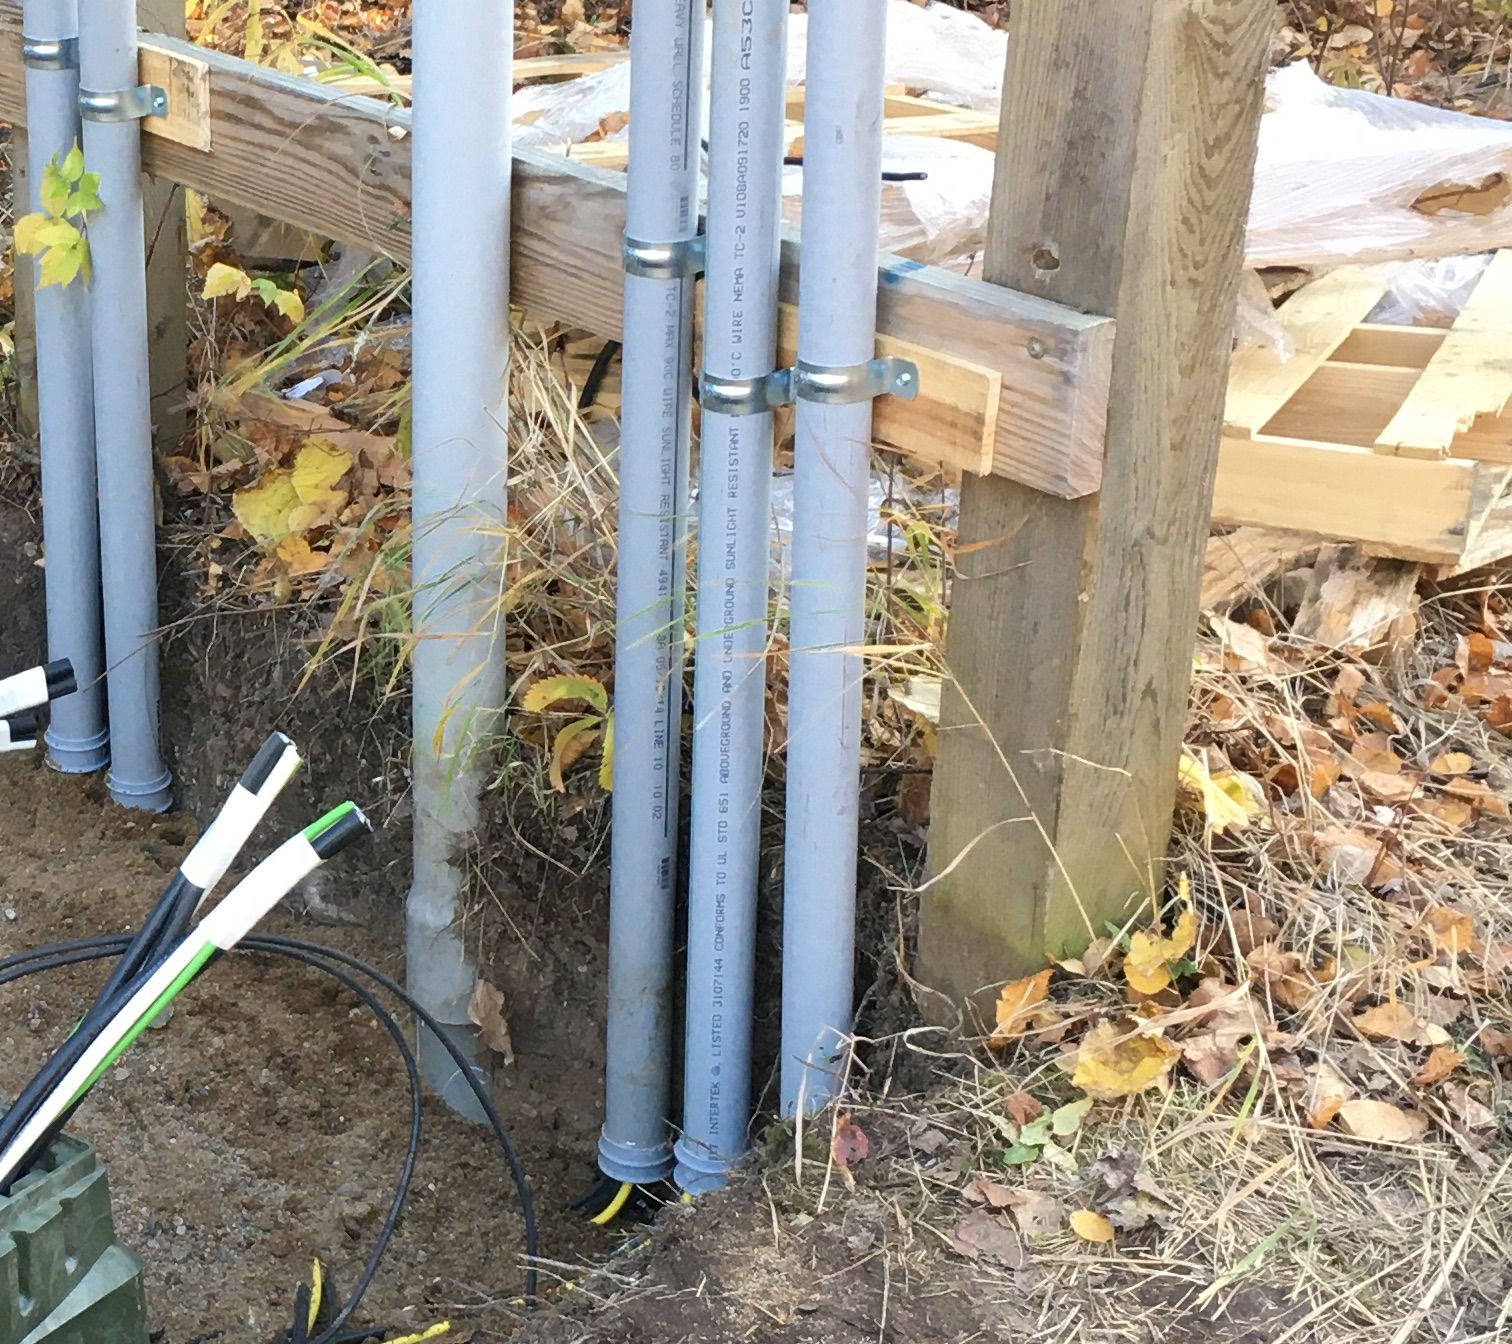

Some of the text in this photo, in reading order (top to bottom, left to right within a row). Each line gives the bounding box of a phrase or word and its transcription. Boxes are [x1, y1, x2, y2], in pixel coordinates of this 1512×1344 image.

[739, 78, 750, 112] 1900
[670, 80, 683, 146] SCHEDULE
[670, 155, 680, 171] 80
[734, 225, 746, 260] TC-2
[665, 286, 676, 317] TC-2
[734, 268, 744, 302] NEMA
[664, 325, 675, 348] MAX
[732, 310, 742, 344] WIRE
[662, 388, 673, 418] WIRE
[660, 426, 672, 486] SUNLIGHT
[728, 426, 740, 498] RESISTANT
[658, 494, 670, 560] RESISTANT
[726, 507, 736, 570] SUNLIGHT
[723, 578, 735, 663] UNDEGROUND
[722, 670, 732, 694] AND
[654, 720, 664, 750] LINE
[720, 701, 732, 784] ABOVEGROUND
[653, 757, 664, 770] 10
[653, 786, 662, 798] 10
[718, 792, 729, 814] 651
[652, 806, 662, 820] 02
[718, 820, 728, 843] STD
[717, 850, 728, 865] UL
[716, 872, 727, 886] TO
[714, 894, 726, 952] CONFORMS
[712, 958, 724, 1008] 3107144
[712, 1014, 722, 1057] LISTED
[709, 1082, 720, 1135] INTERTEK
